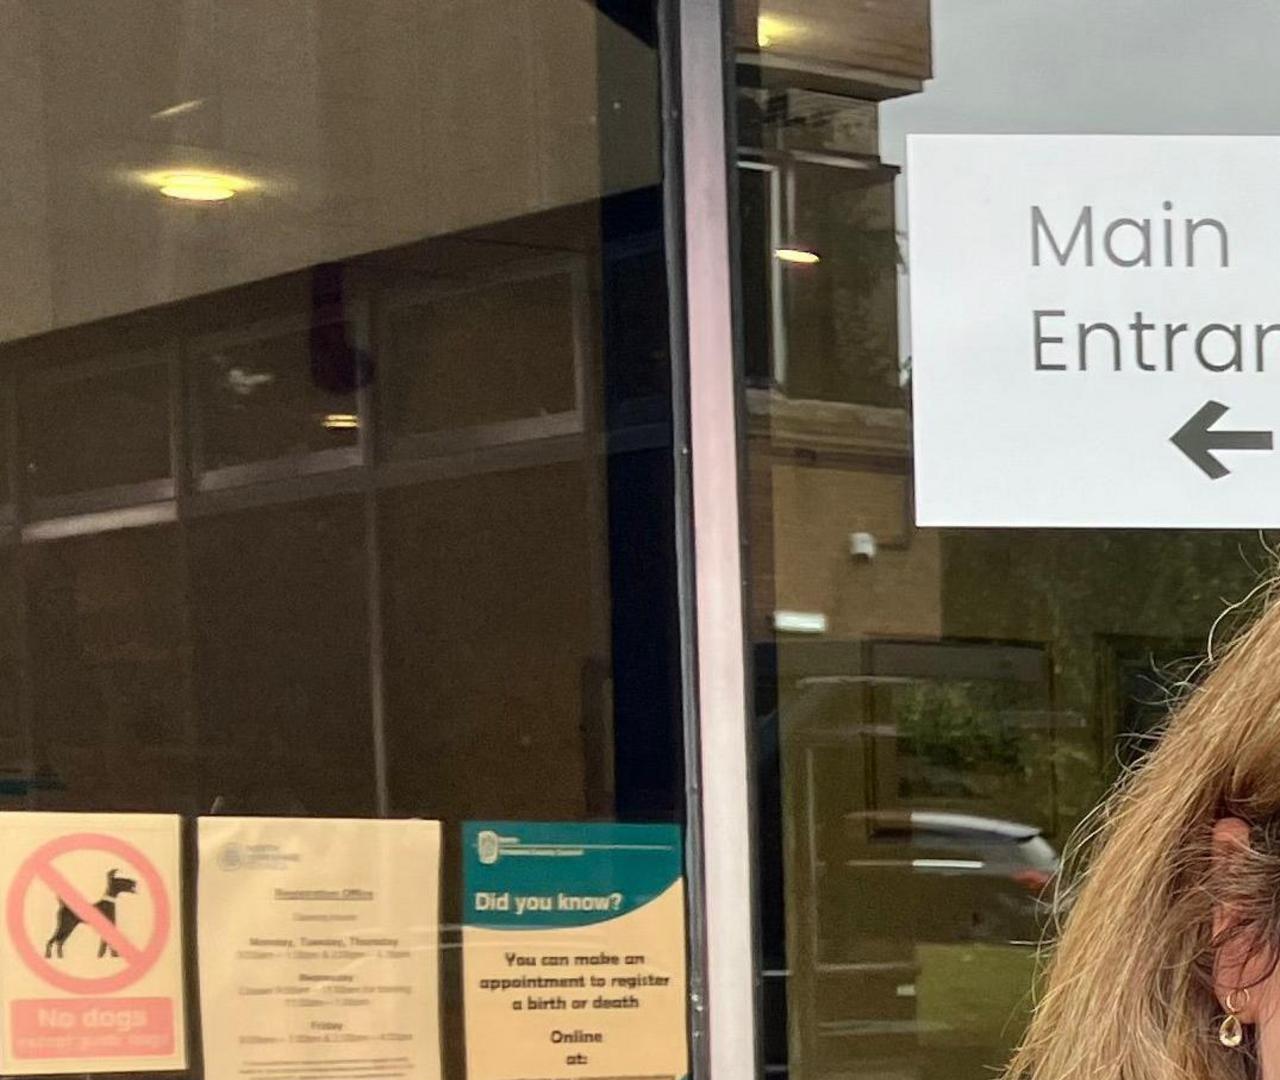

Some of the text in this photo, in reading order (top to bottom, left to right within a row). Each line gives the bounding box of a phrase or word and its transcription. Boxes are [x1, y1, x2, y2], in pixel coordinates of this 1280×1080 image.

[1031, 201, 1229, 268] Main
[475, 893, 622, 915] Did you know?
[505, 952, 645, 966] You can make an
[479, 975, 670, 990] appointment to register
[512, 995, 639, 1010] a birth or death
[37, 1007, 148, 1032] No dogs
[550, 1029, 603, 1044] Online
[566, 1054, 588, 1066] at:
